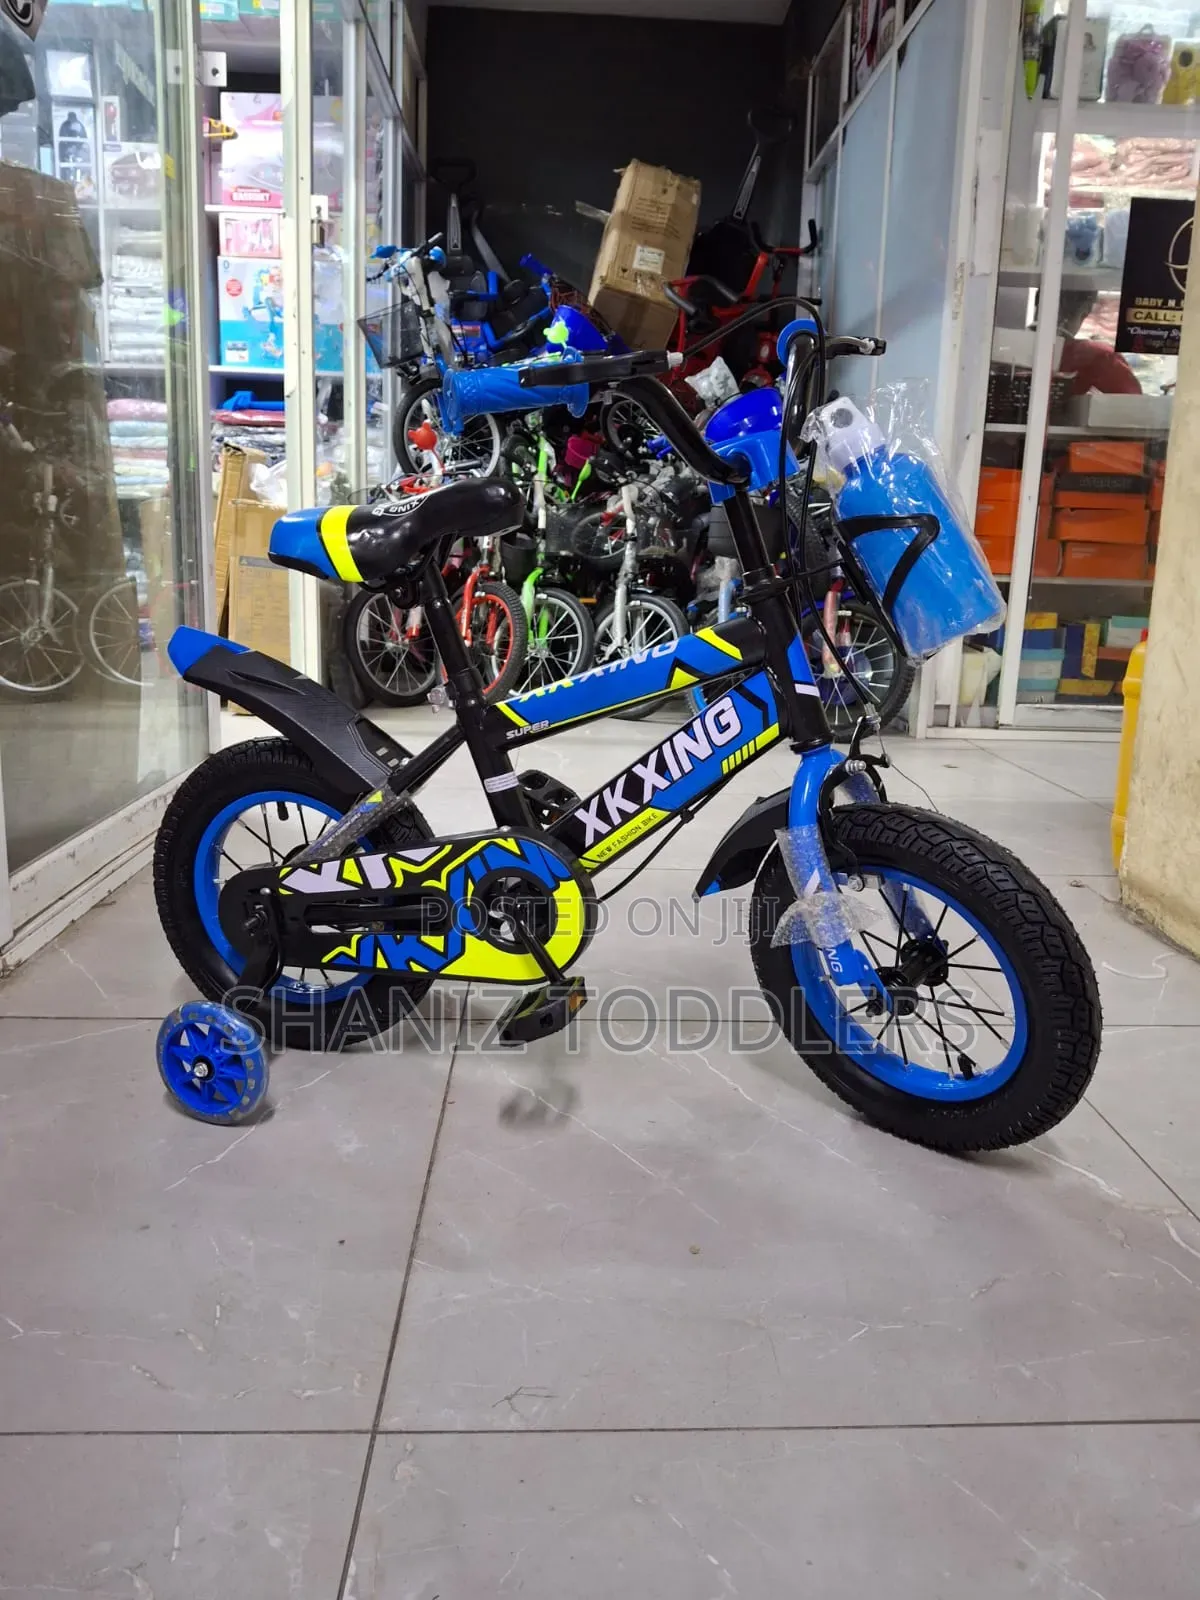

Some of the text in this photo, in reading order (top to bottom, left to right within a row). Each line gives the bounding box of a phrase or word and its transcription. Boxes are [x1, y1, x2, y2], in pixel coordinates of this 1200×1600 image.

[1134, 311, 1177, 322] CALL:
[505, 719, 550, 740] SUPER
[573, 696, 742, 848] XKXING
[596, 812, 658, 859] NEW FASHION BIKE
